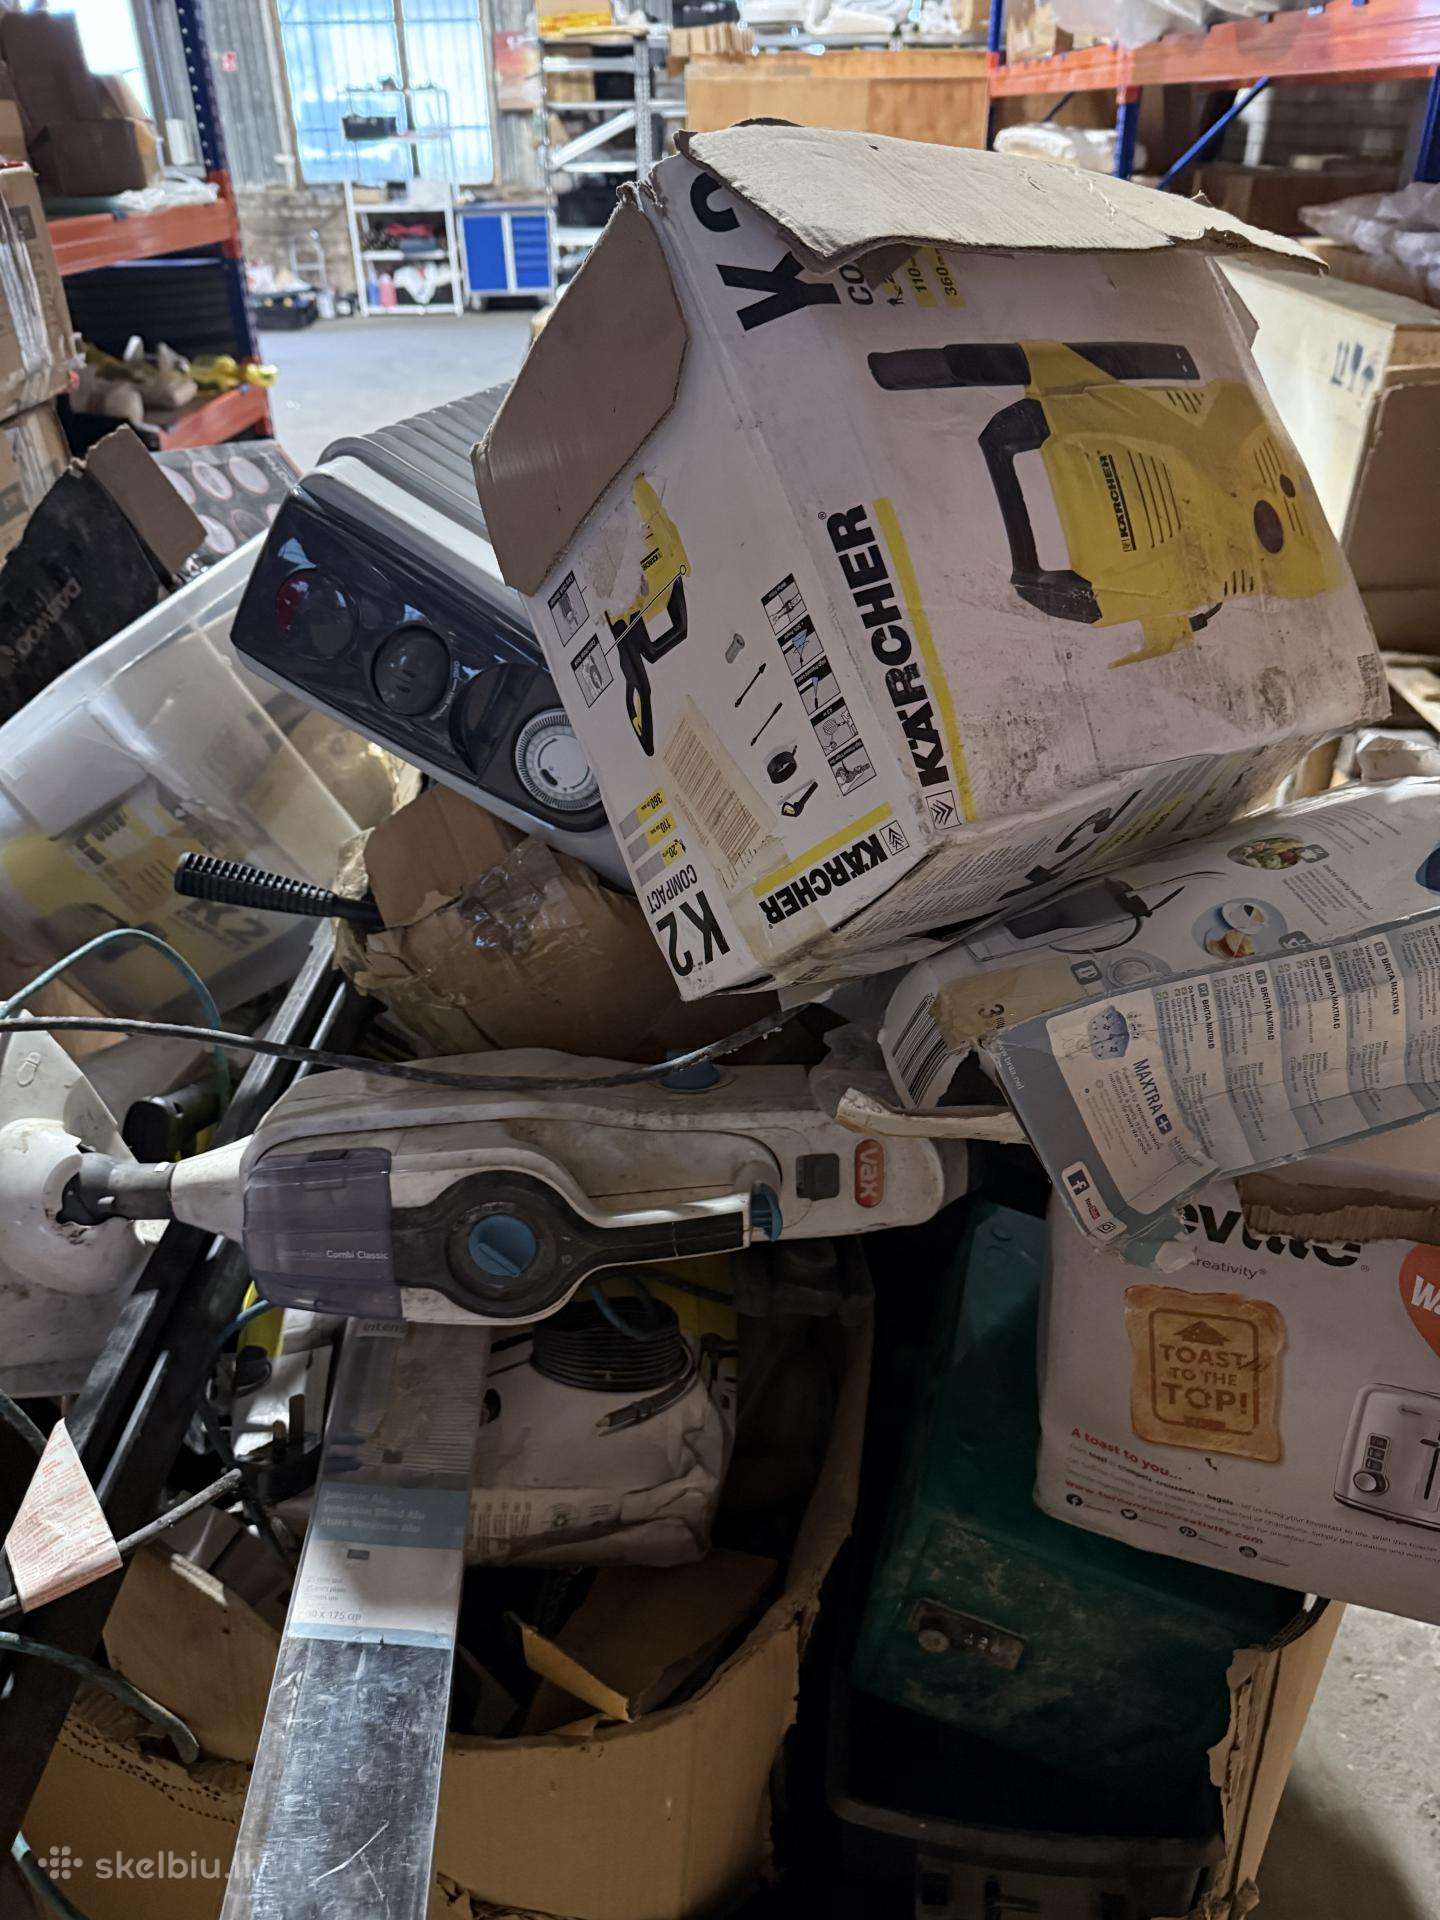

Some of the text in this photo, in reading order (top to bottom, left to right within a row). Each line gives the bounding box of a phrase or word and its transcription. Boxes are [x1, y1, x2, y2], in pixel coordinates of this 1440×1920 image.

[935, 264, 958, 296] 360
[1099, 453, 1132, 538] KÄRCHER
[826, 503, 950, 788] KÄRCHER
[646, 863, 698, 915] COMPACT
[759, 833, 889, 926] KÄRCHER
[1325, 972, 1338, 996] BRITA
[1381, 957, 1396, 982] BRITA
[1202, 999, 1213, 1024] BRITA
[1260, 986, 1273, 1010] BRITA
[326, 1249, 355, 1258] Combi
[356, 1249, 389, 1259] Classic
[1159, 1343, 1248, 1371] TOAST
[1169, 1367, 1238, 1387] TO THE
[1161, 1382, 1249, 1415] TOP!
[1071, 1427, 1081, 1438] A
[1085, 1433, 1121, 1454] toast
[1123, 1448, 1139, 1463] to
